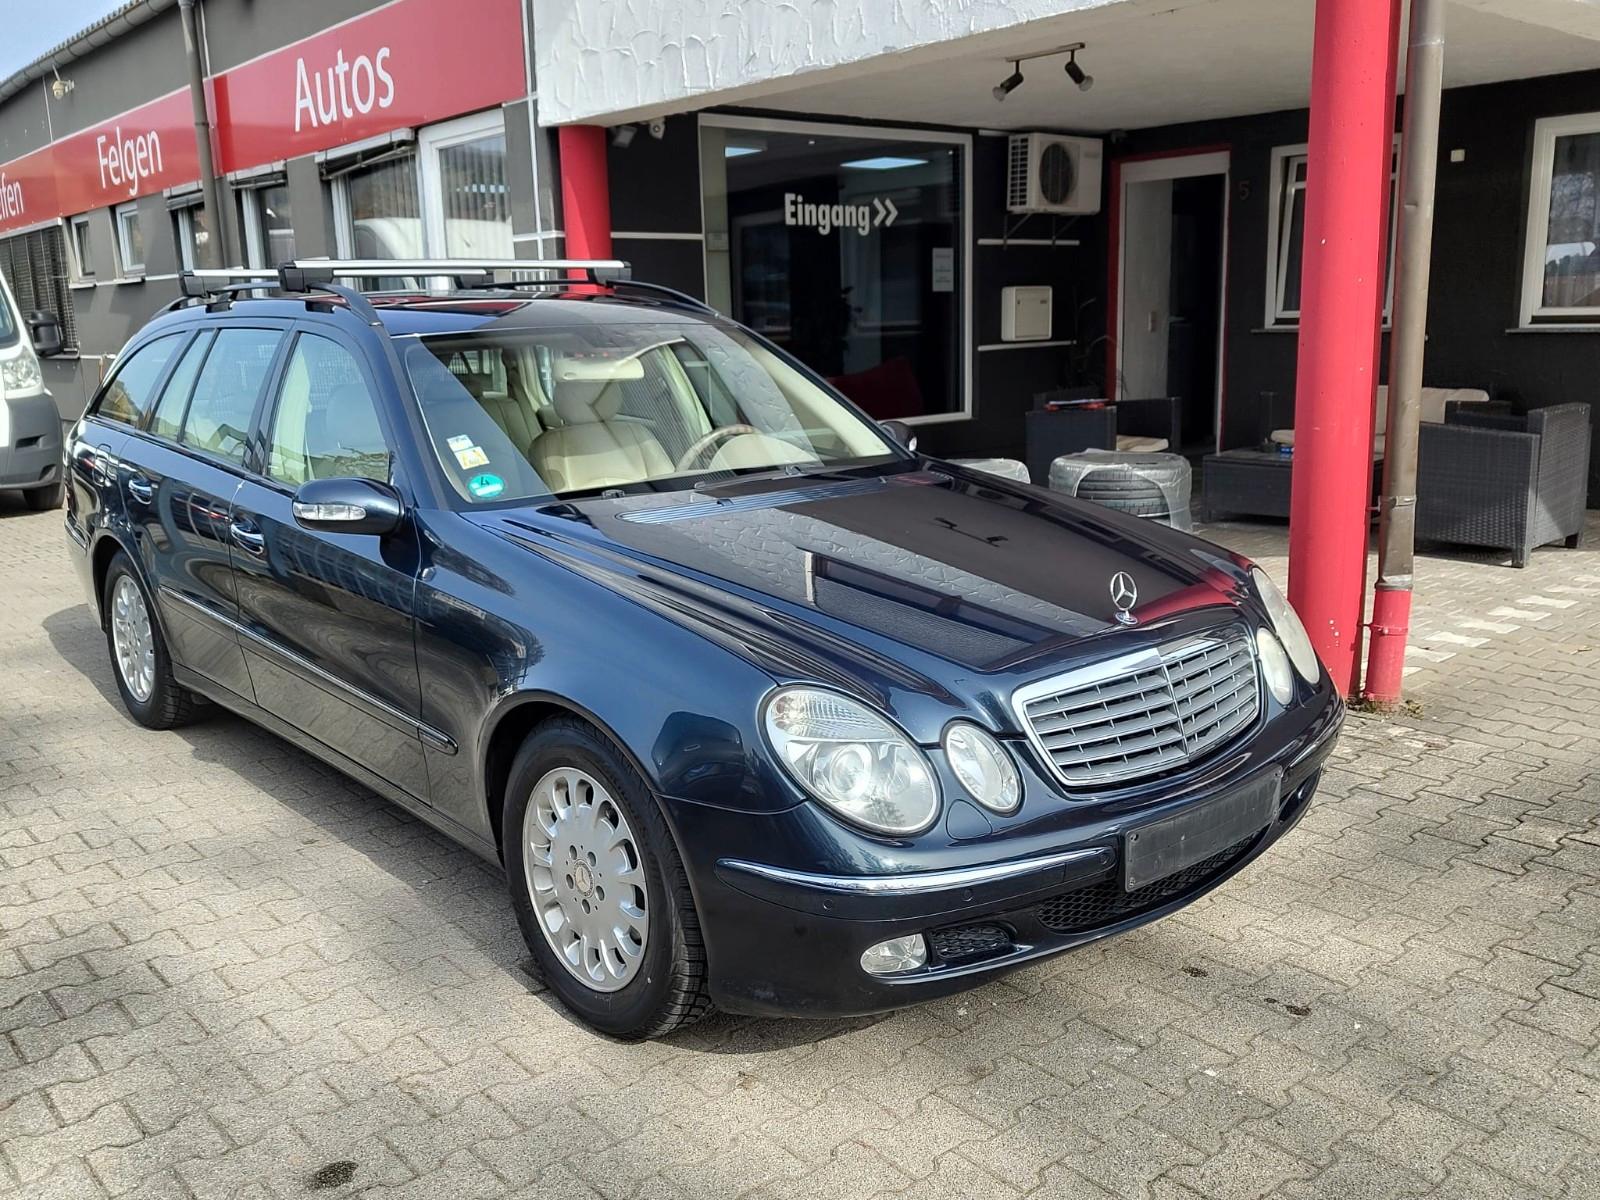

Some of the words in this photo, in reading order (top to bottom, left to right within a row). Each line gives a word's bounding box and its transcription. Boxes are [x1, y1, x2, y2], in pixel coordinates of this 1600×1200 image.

[295, 47, 394, 132] Autos
[97, 126, 163, 196] Felgen
[784, 193, 870, 236] Eingang
[1239, 180, 1250, 201] 5
